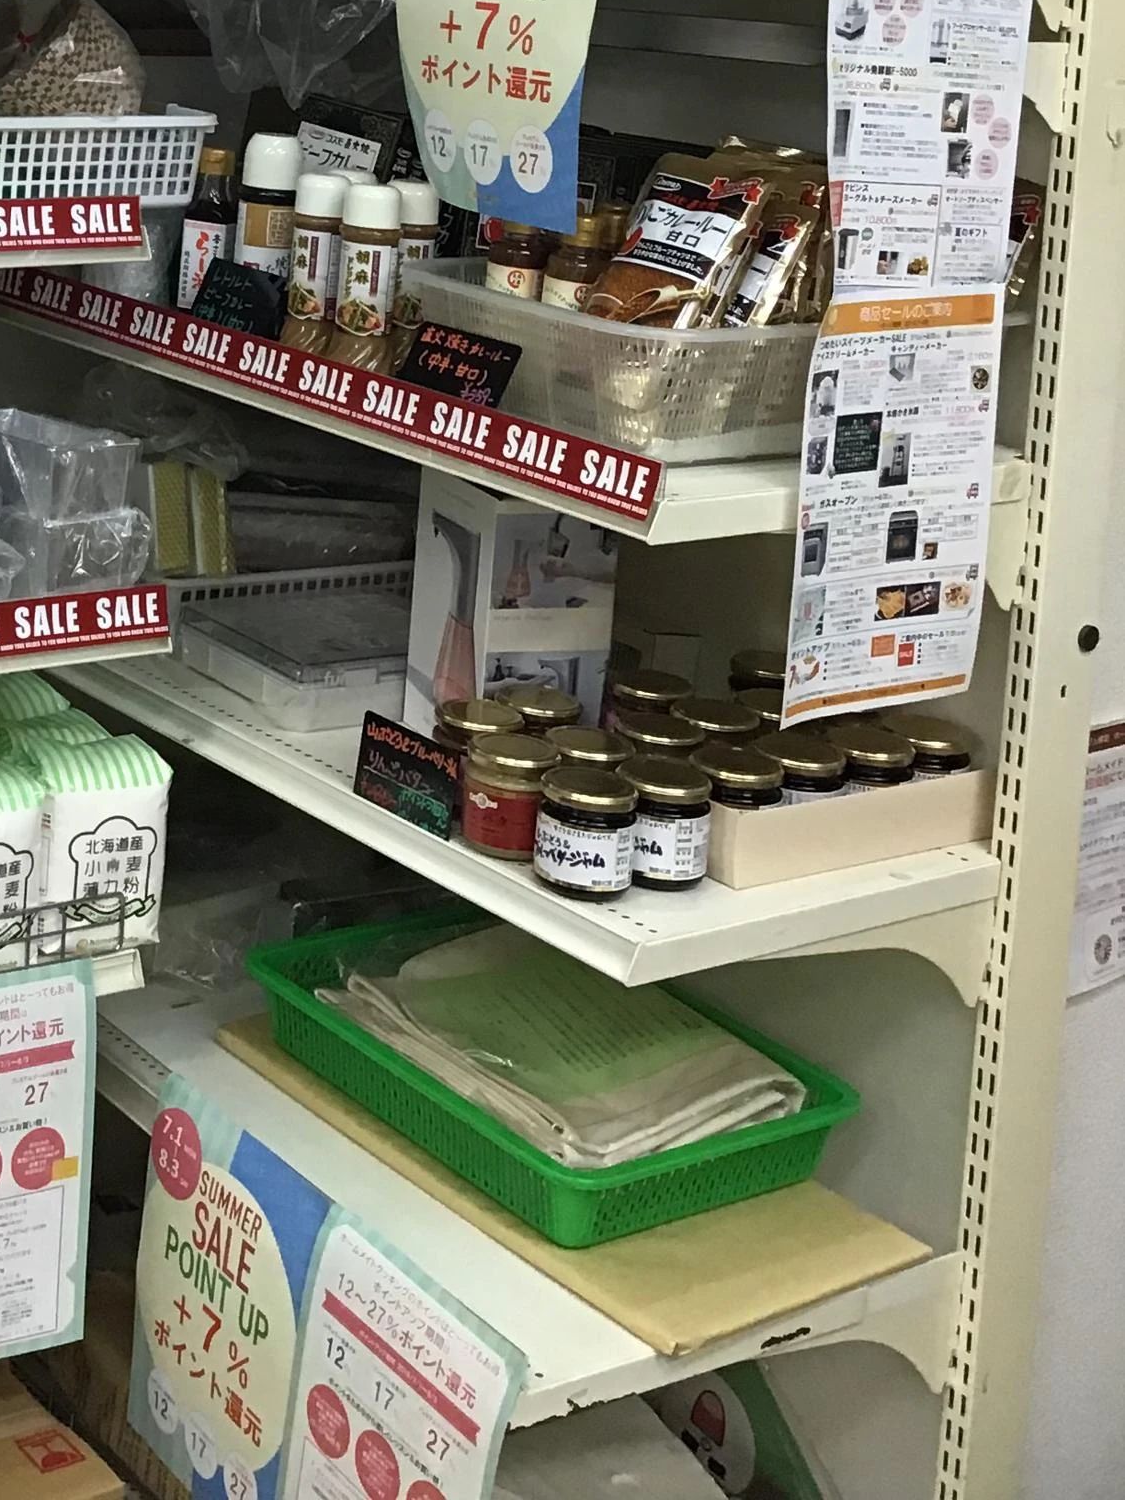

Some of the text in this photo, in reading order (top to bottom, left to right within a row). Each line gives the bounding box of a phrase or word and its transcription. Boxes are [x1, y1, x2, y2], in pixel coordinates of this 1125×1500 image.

[421, 55, 551, 102] ポイント還元
[518, 152, 539, 176] 27
[71, 203, 133, 234] SALE
[666, 230, 700, 247] 甘口
[78, 291, 650, 502] SALE SALE SALE SALE SALE
[96, 593, 159, 630] SALE
[85, 836, 144, 855] 北海道産
[162, 1116, 184, 1146] 7.1
[159, 1148, 179, 1178] 8.3
[199, 1170, 263, 1243] SUMMER
[192, 1203, 256, 1294] SALE
[165, 1225, 269, 1346] POINT UP
[154, 1320, 263, 1448] ポイント還元
